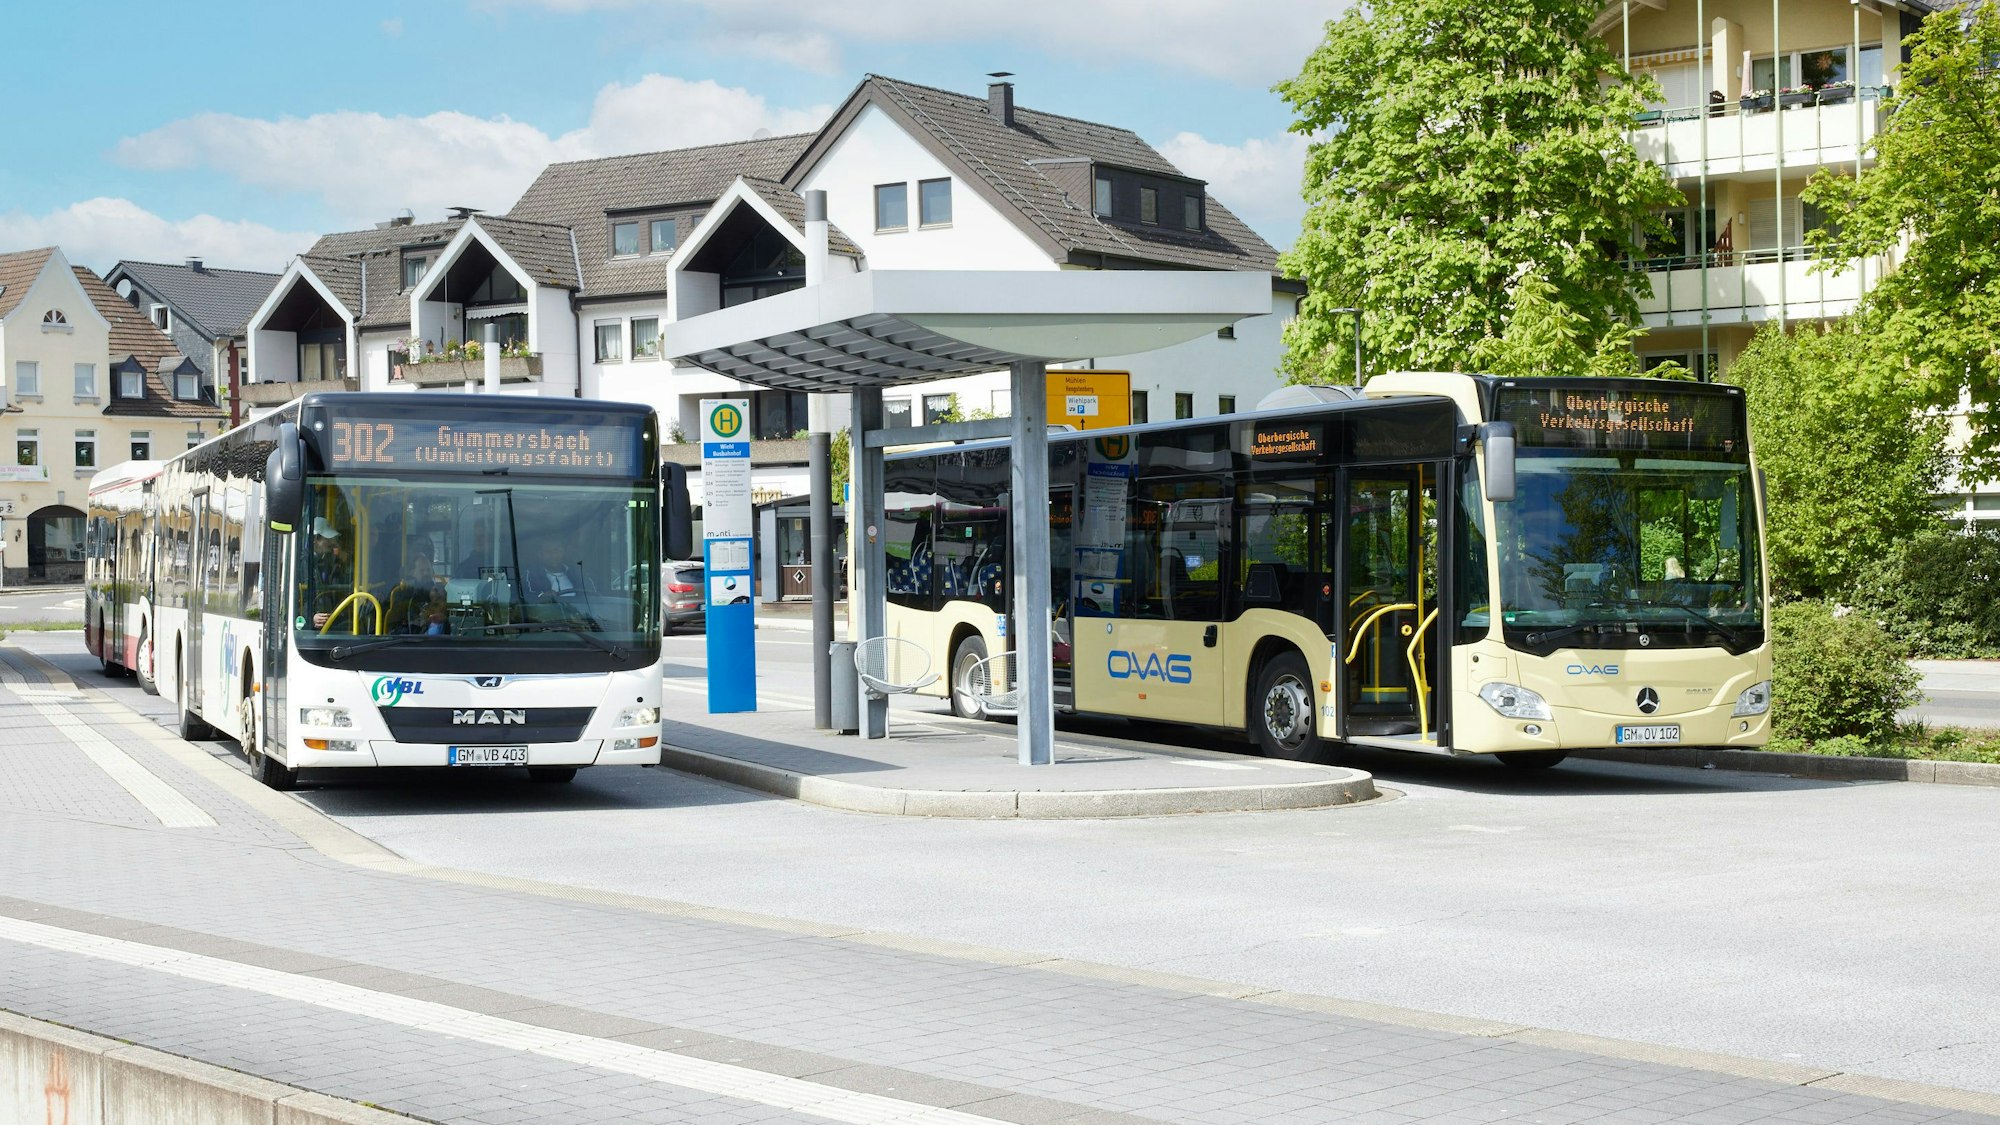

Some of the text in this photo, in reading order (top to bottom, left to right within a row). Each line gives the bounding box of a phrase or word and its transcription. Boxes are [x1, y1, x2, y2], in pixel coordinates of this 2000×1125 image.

[1566, 396, 1669, 415] Oberbergische
[720, 412, 732, 430] H
[1540, 414, 1694, 433] Verkehrsgesellschaft
[333, 422, 394, 462] 302
[438, 426, 589, 450] Gummersbach
[1258, 430, 1310, 444] Oberbergische
[1250, 440, 1316, 455] Verkehrsgesellschaft
[415, 447, 613, 466] (Umleitungsfahrt)
[1108, 650, 1192, 684] OVAG
[1566, 665, 1619, 674] OVAG
[386, 677, 424, 694] VBL
[453, 710, 526, 724] MAN
[1321, 706, 1334, 716] 102
[1624, 728, 1678, 740] GM OV 102
[458, 749, 474, 761] GM
[484, 749, 499, 760] VB
[502, 749, 525, 760] 403
